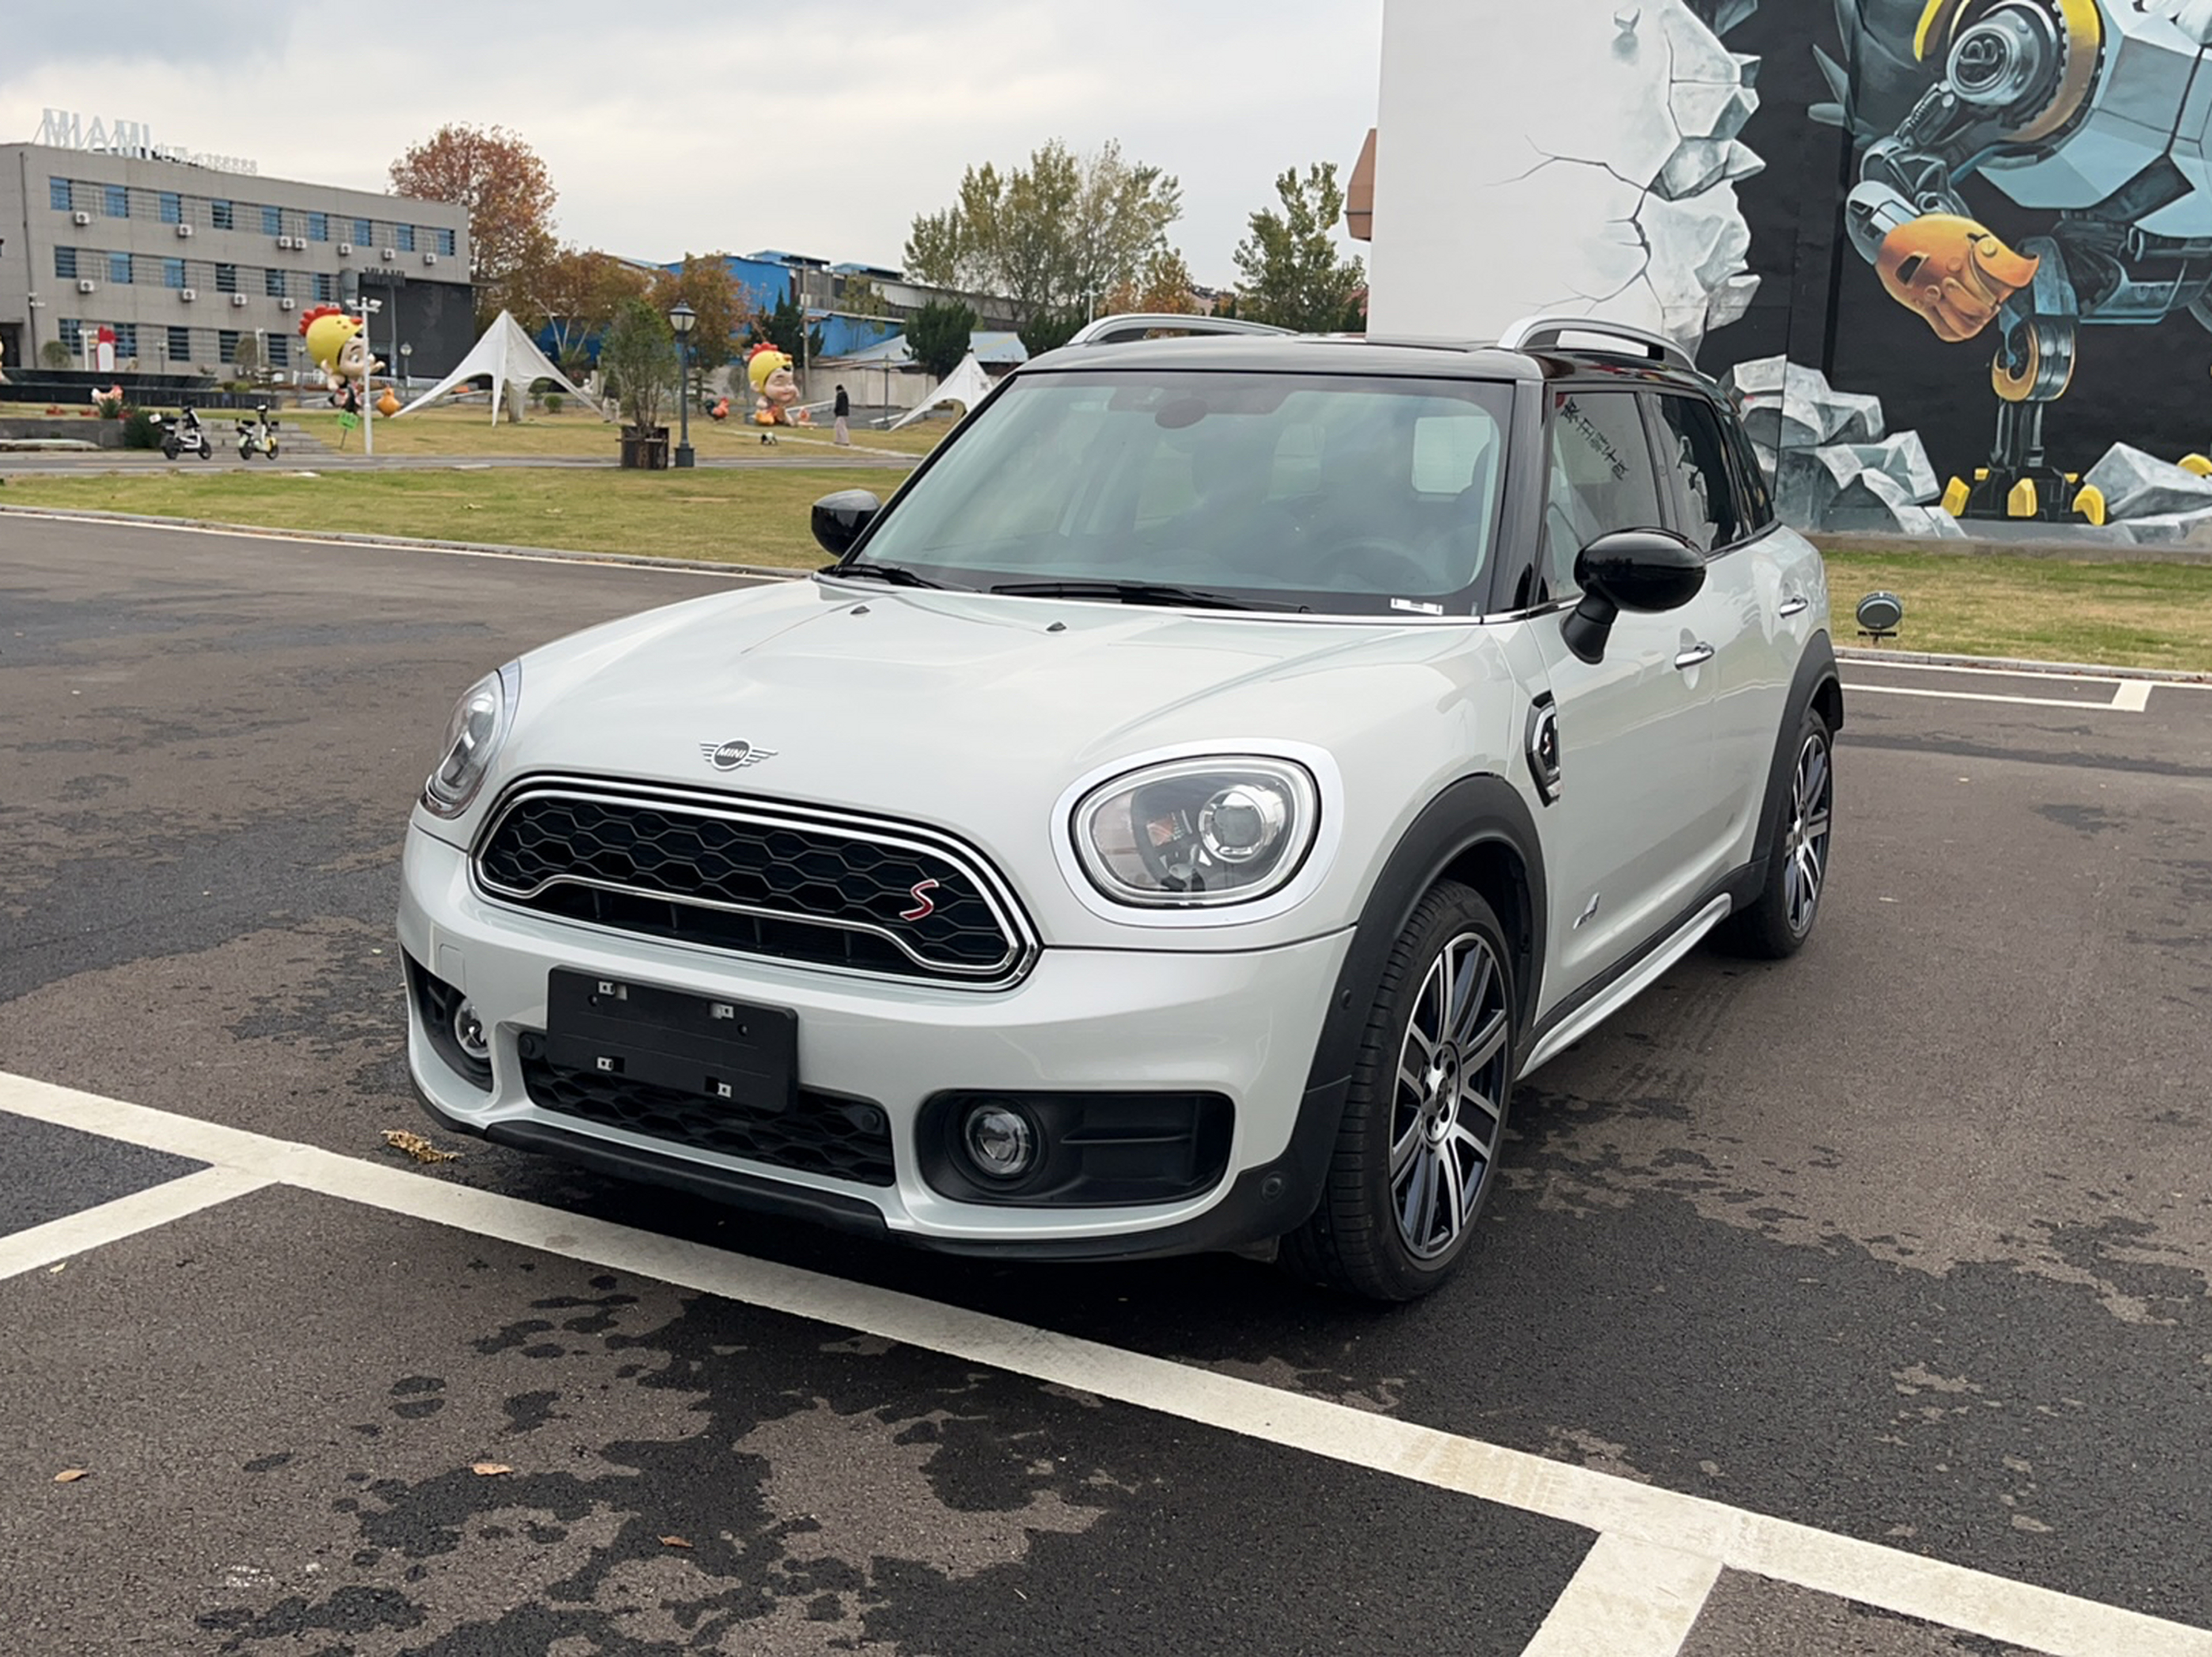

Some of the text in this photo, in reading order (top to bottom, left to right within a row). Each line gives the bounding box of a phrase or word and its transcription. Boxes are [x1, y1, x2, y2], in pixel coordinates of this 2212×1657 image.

[43, 108, 151, 160] MIAMI
[717, 747, 747, 759] MINI
[899, 878, 940, 921] S
